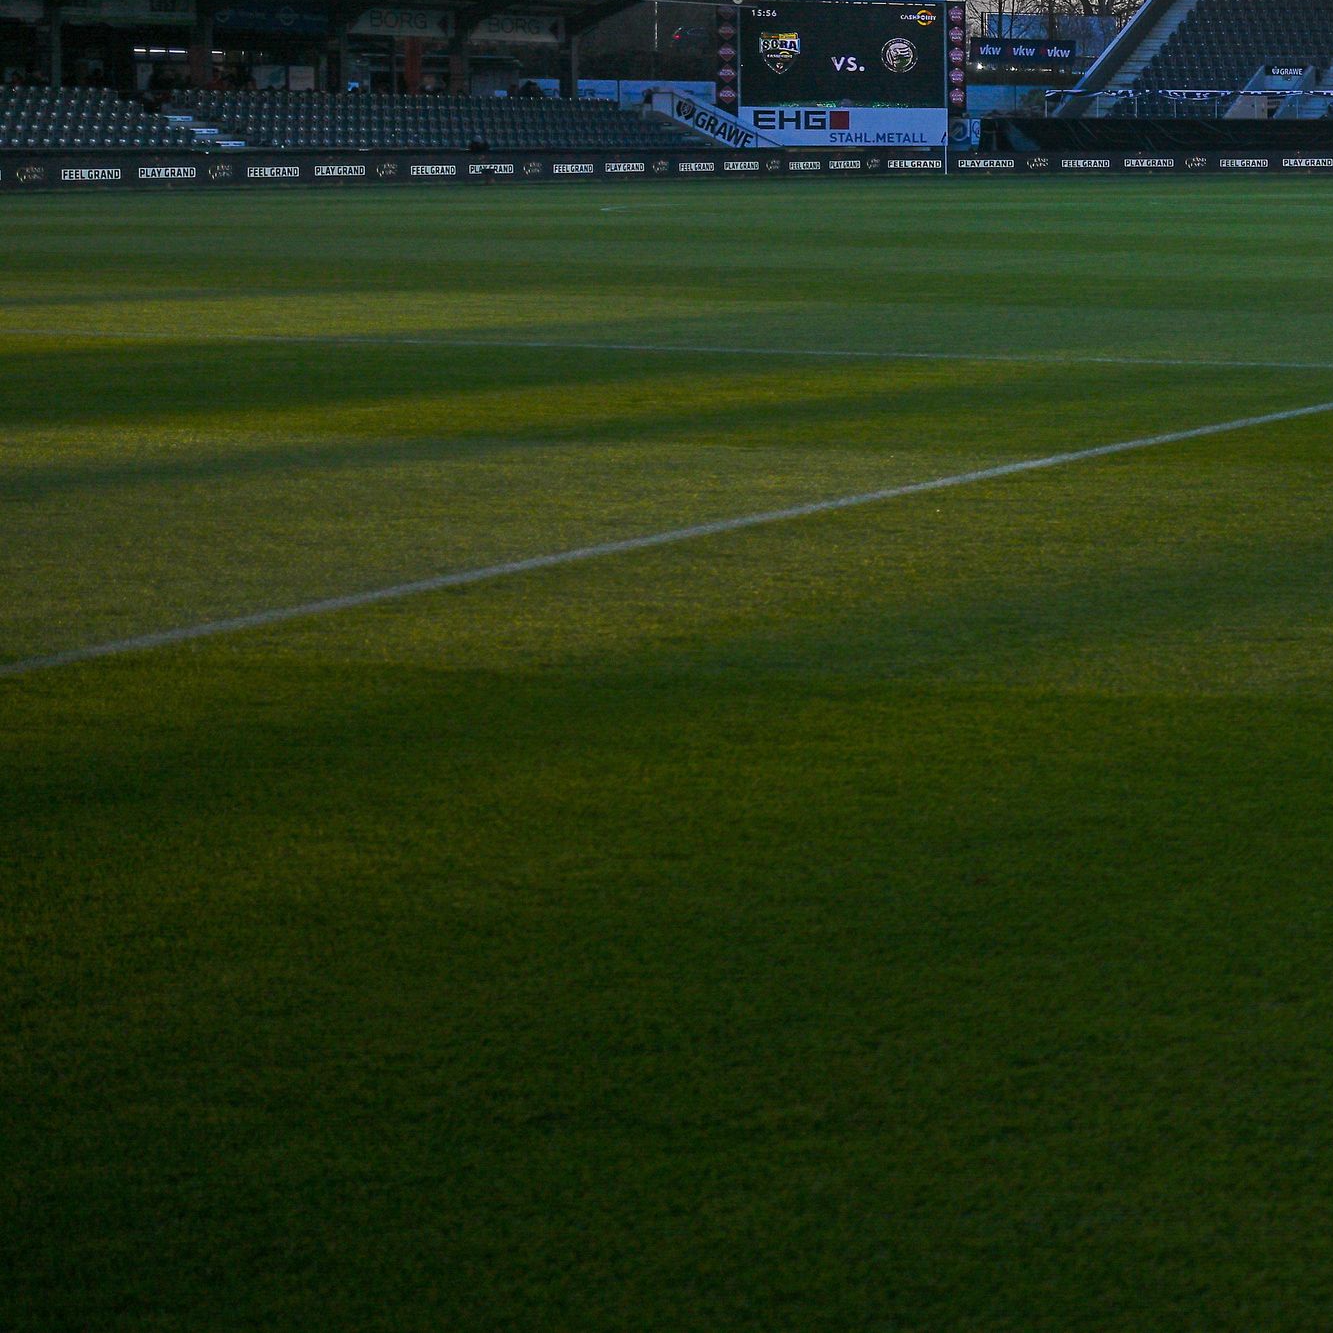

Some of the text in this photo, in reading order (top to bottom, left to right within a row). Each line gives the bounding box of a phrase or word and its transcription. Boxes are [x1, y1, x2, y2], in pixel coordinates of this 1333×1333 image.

[370, 8, 427, 30] BORG
[752, 9, 777, 17] 15:56
[979, 44, 1001, 56] vkw
[1013, 45, 1035, 57] vkw
[1047, 46, 1070, 59] vkw
[1280, 68, 1303, 76] GRAWE
[753, 110, 826, 130] EHG
[829, 132, 927, 144] STAHL.METALL
[64, 170, 120, 179] FEEL GRAND
[141, 168, 195, 177] PLAY GRAND
[249, 168, 298, 176] FEEL GRAND
